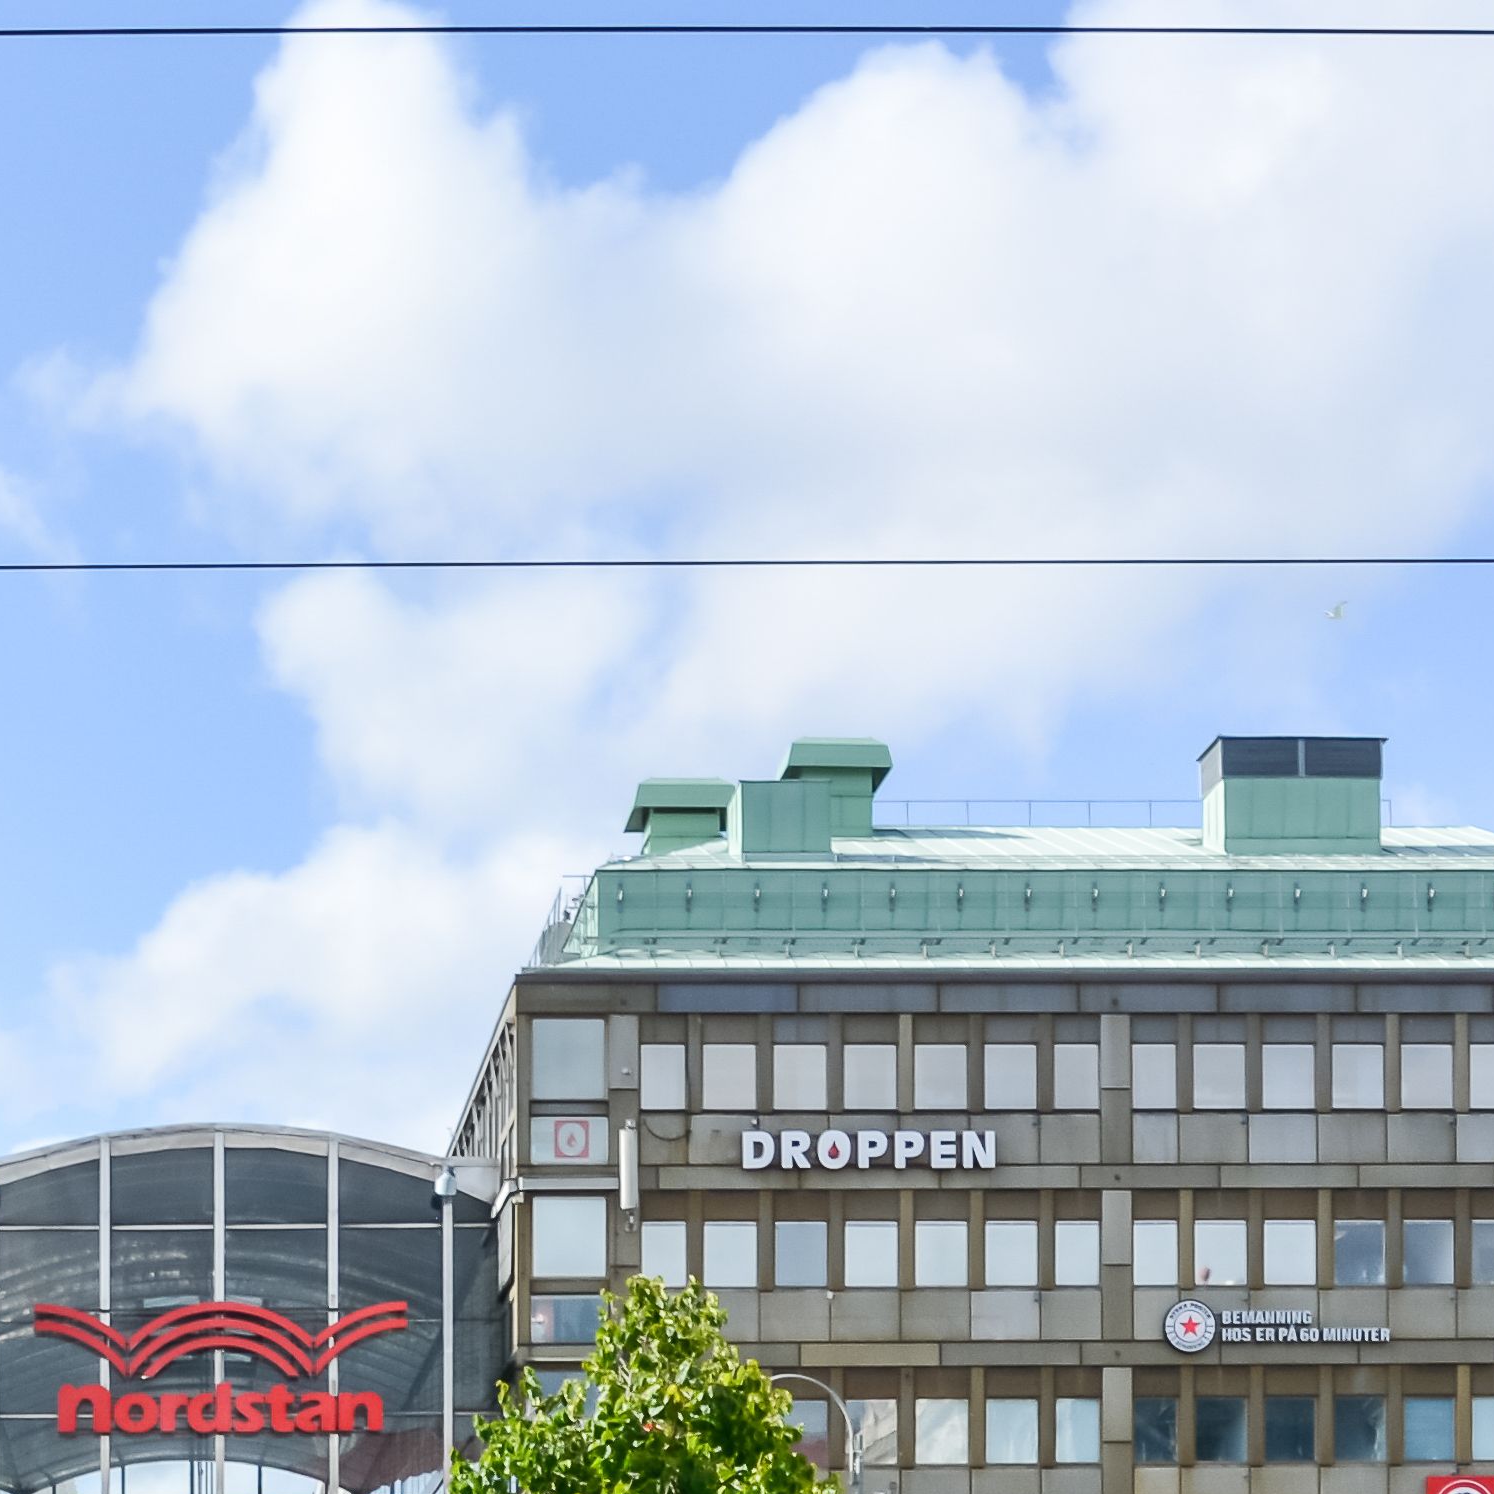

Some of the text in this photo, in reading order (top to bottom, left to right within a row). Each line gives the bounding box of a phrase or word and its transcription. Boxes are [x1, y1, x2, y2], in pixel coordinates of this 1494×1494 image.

[741, 1130, 997, 1170] DROPPEN
[1221, 1310, 1313, 1325] BEMANNING
[1221, 1324, 1391, 1343] HOS ER PÅ 60 MINUTER
